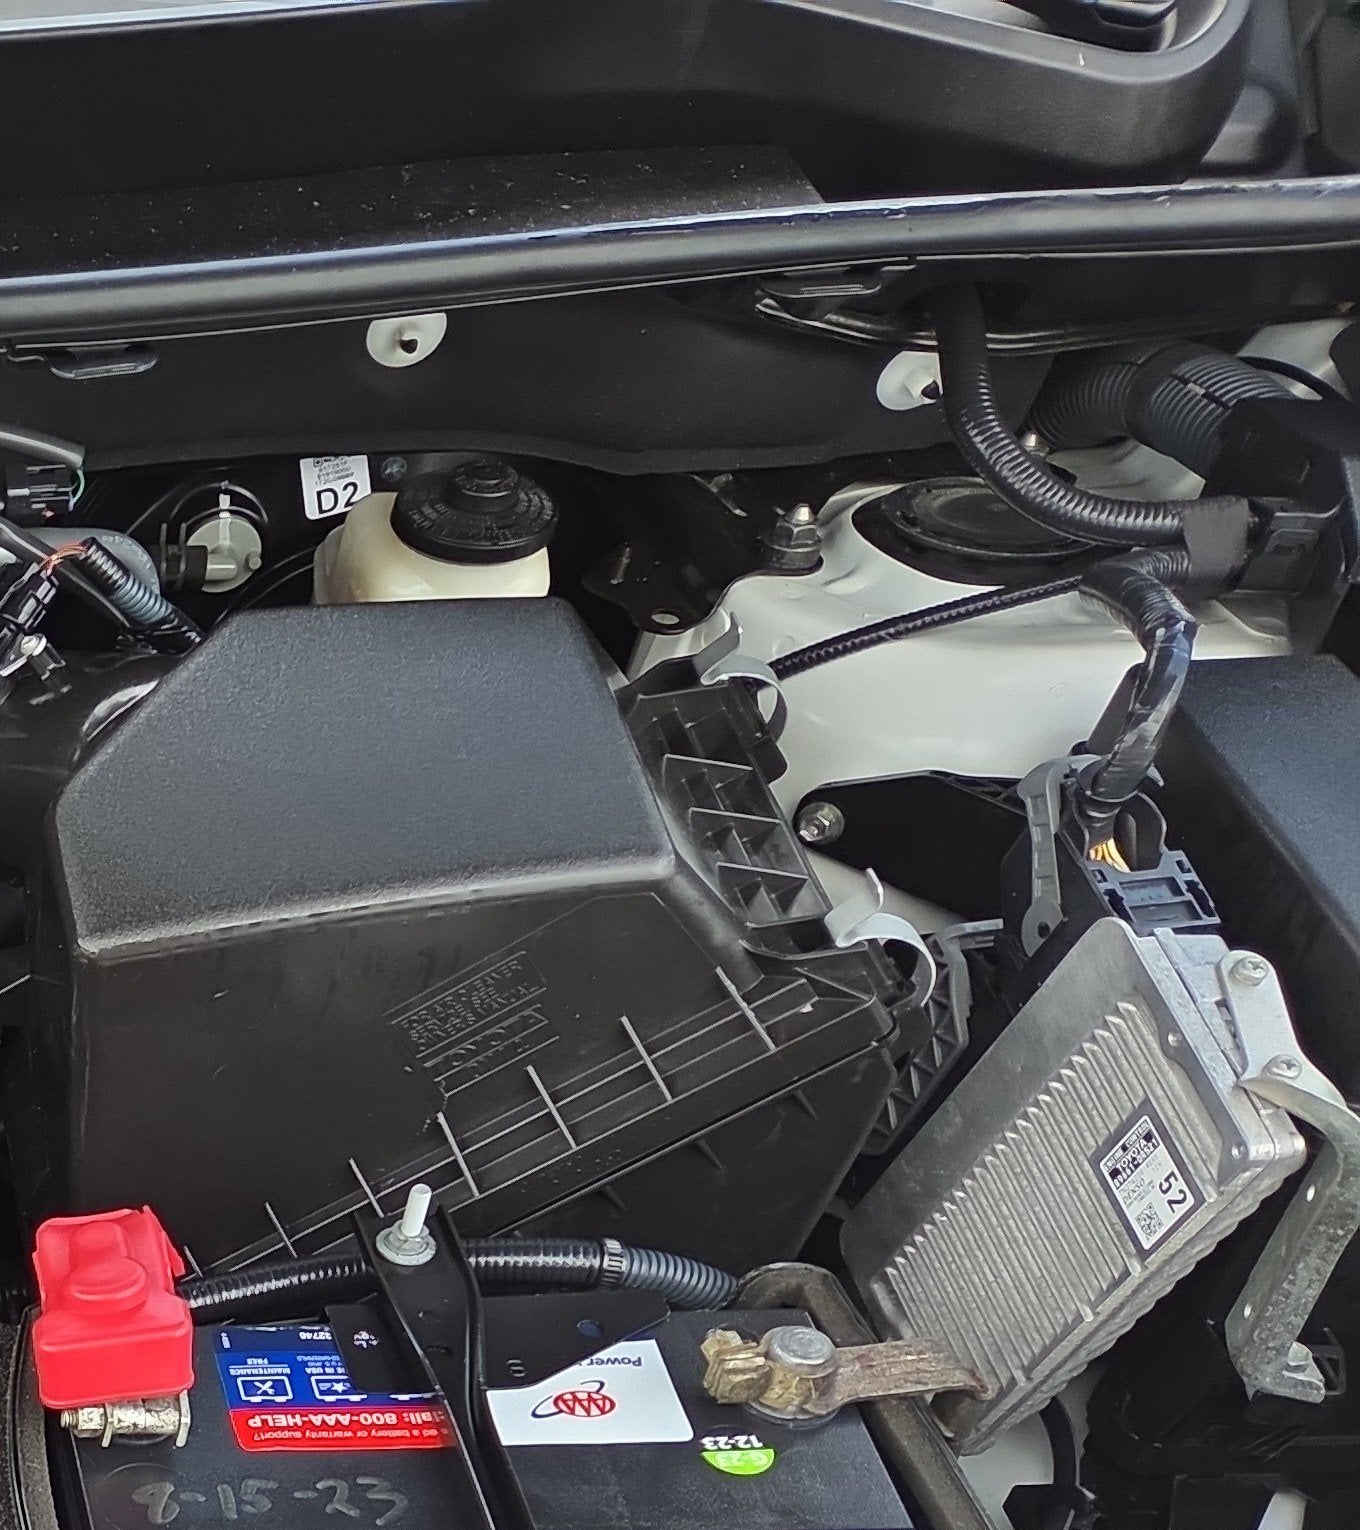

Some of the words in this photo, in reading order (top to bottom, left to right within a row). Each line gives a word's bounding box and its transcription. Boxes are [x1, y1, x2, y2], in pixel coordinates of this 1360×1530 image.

[316, 482, 359, 515] D2
[1116, 1138, 1148, 1171] TOYOTA
[1159, 1170, 1187, 1213] 52
[587, 1357, 642, 1367] Power
[552, 1391, 613, 1417] AAA
[247, 1412, 397, 1428] 800-AAA-HELP
[253, 1430, 302, 1441] support?
[305, 1430, 353, 1439] warranty
[356, 1430, 368, 1438] or
[371, 1428, 410, 1438] battery
[700, 1435, 763, 1450] 12-23
[131, 1476, 409, 1526] 8-15-23
